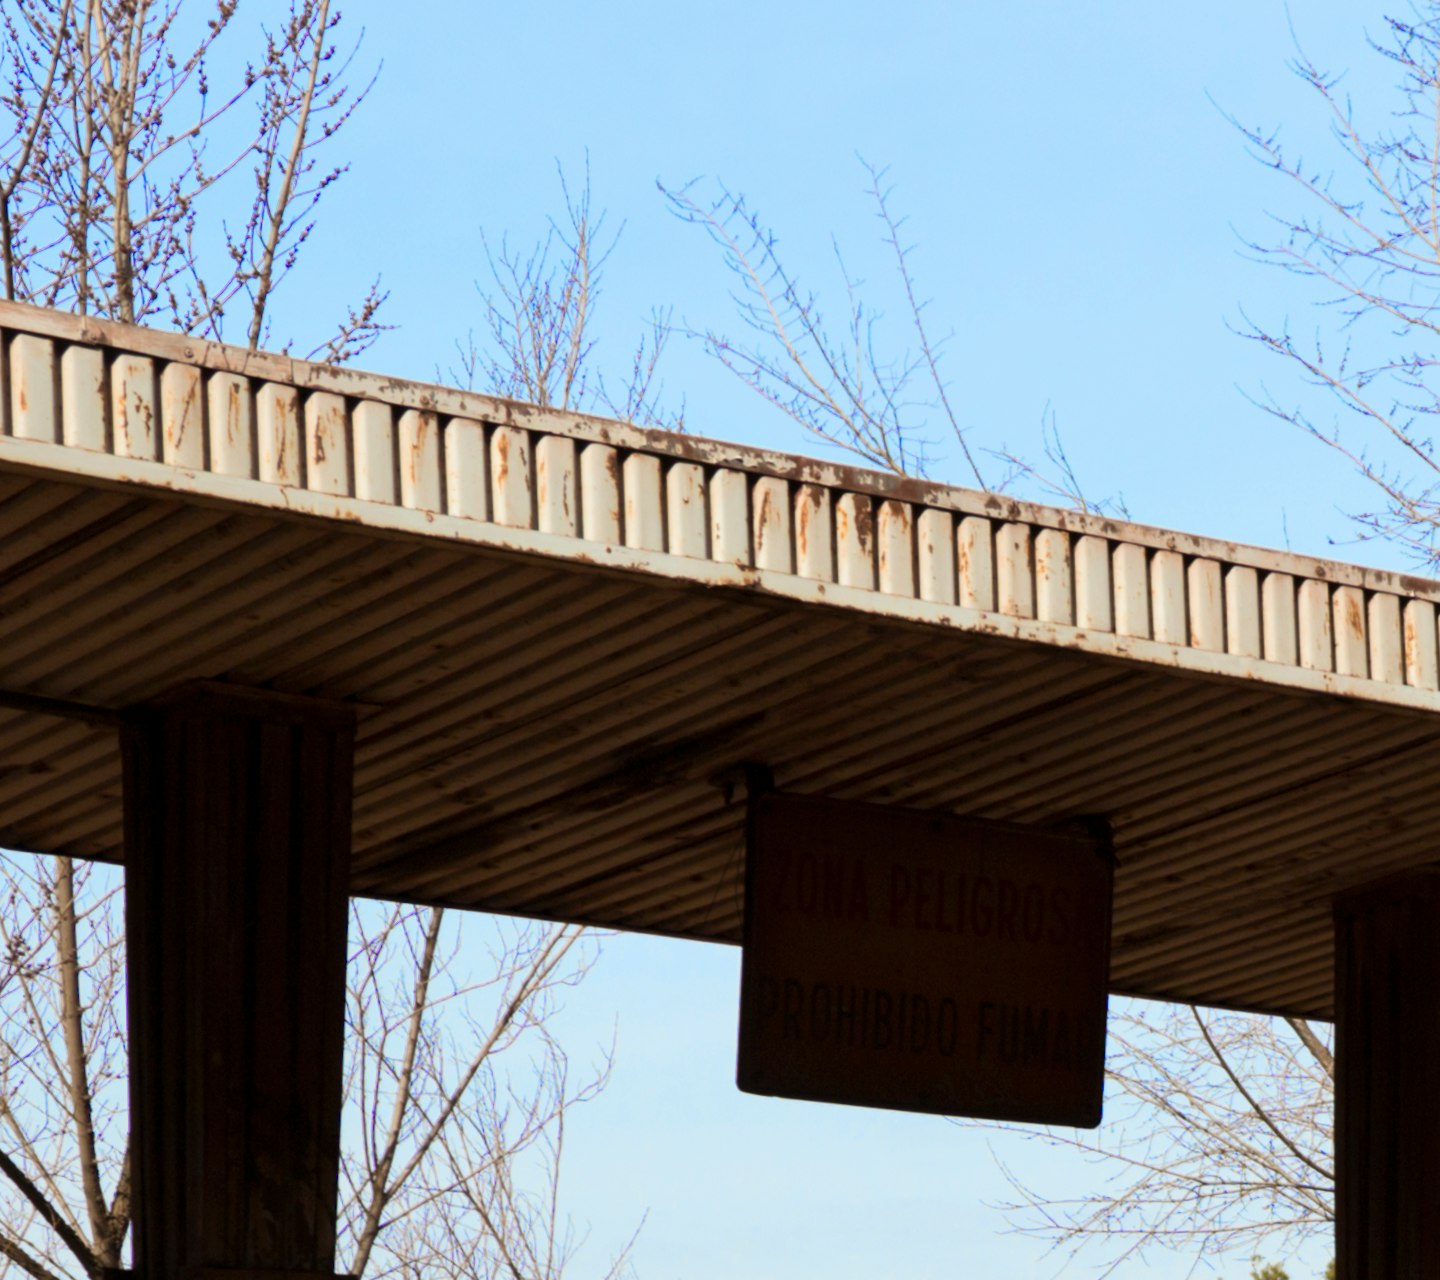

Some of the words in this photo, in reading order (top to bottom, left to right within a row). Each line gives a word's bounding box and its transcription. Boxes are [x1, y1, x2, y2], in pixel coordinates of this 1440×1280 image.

[770, 848, 870, 922] ZONA
[889, 862, 1090, 948] PELIGROSA
[757, 974, 959, 1057] PROHIBIDO
